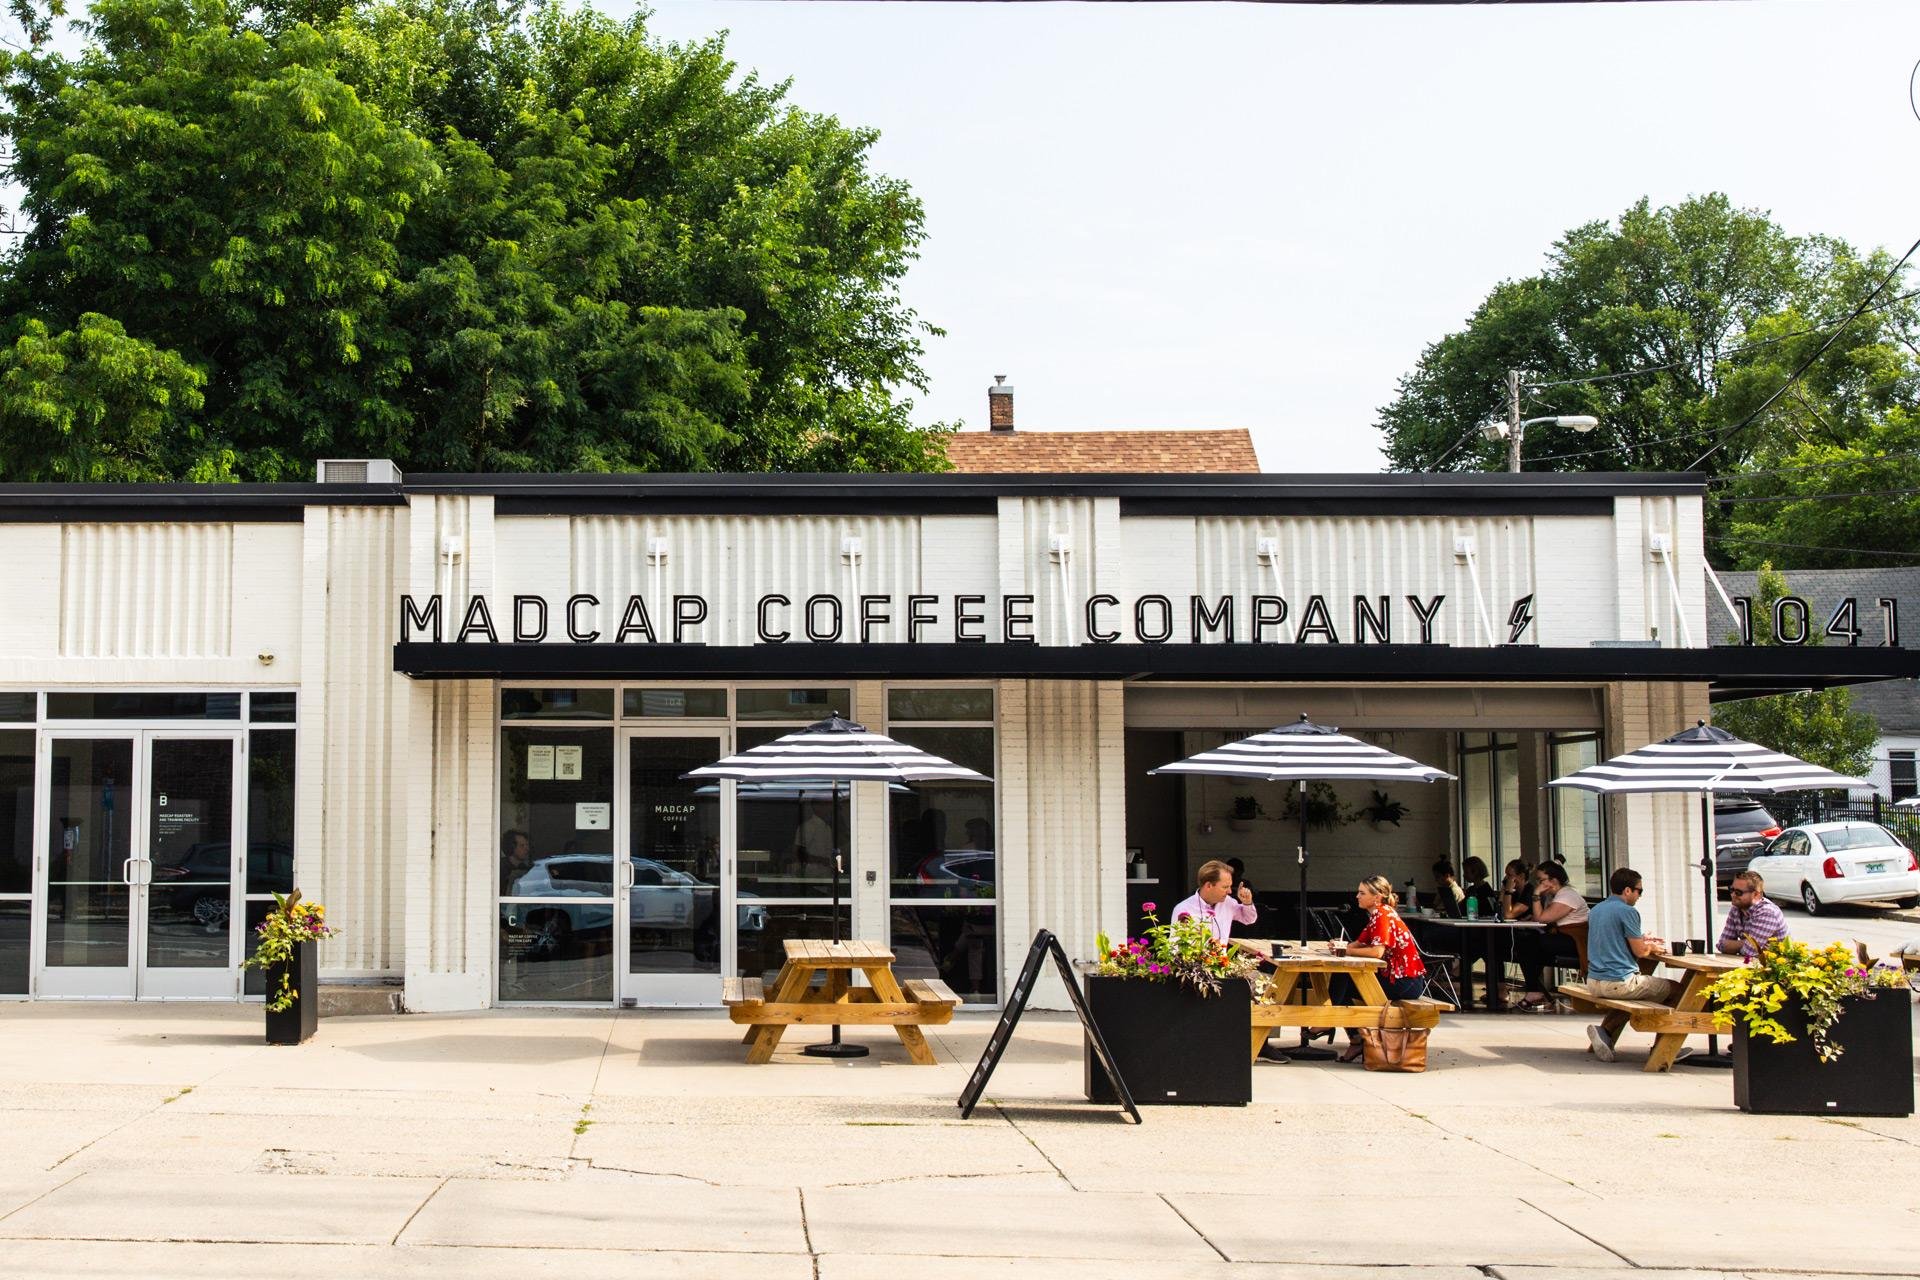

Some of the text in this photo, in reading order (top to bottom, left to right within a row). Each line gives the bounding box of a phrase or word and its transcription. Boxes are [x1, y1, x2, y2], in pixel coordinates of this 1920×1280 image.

[400, 594, 1446, 644] MADCAP COFFEE COMPANY
[1733, 596, 1899, 647] 1041
[159, 795, 168, 806] B
[655, 805, 696, 813] MADCAP
[508, 915, 517, 927] C
